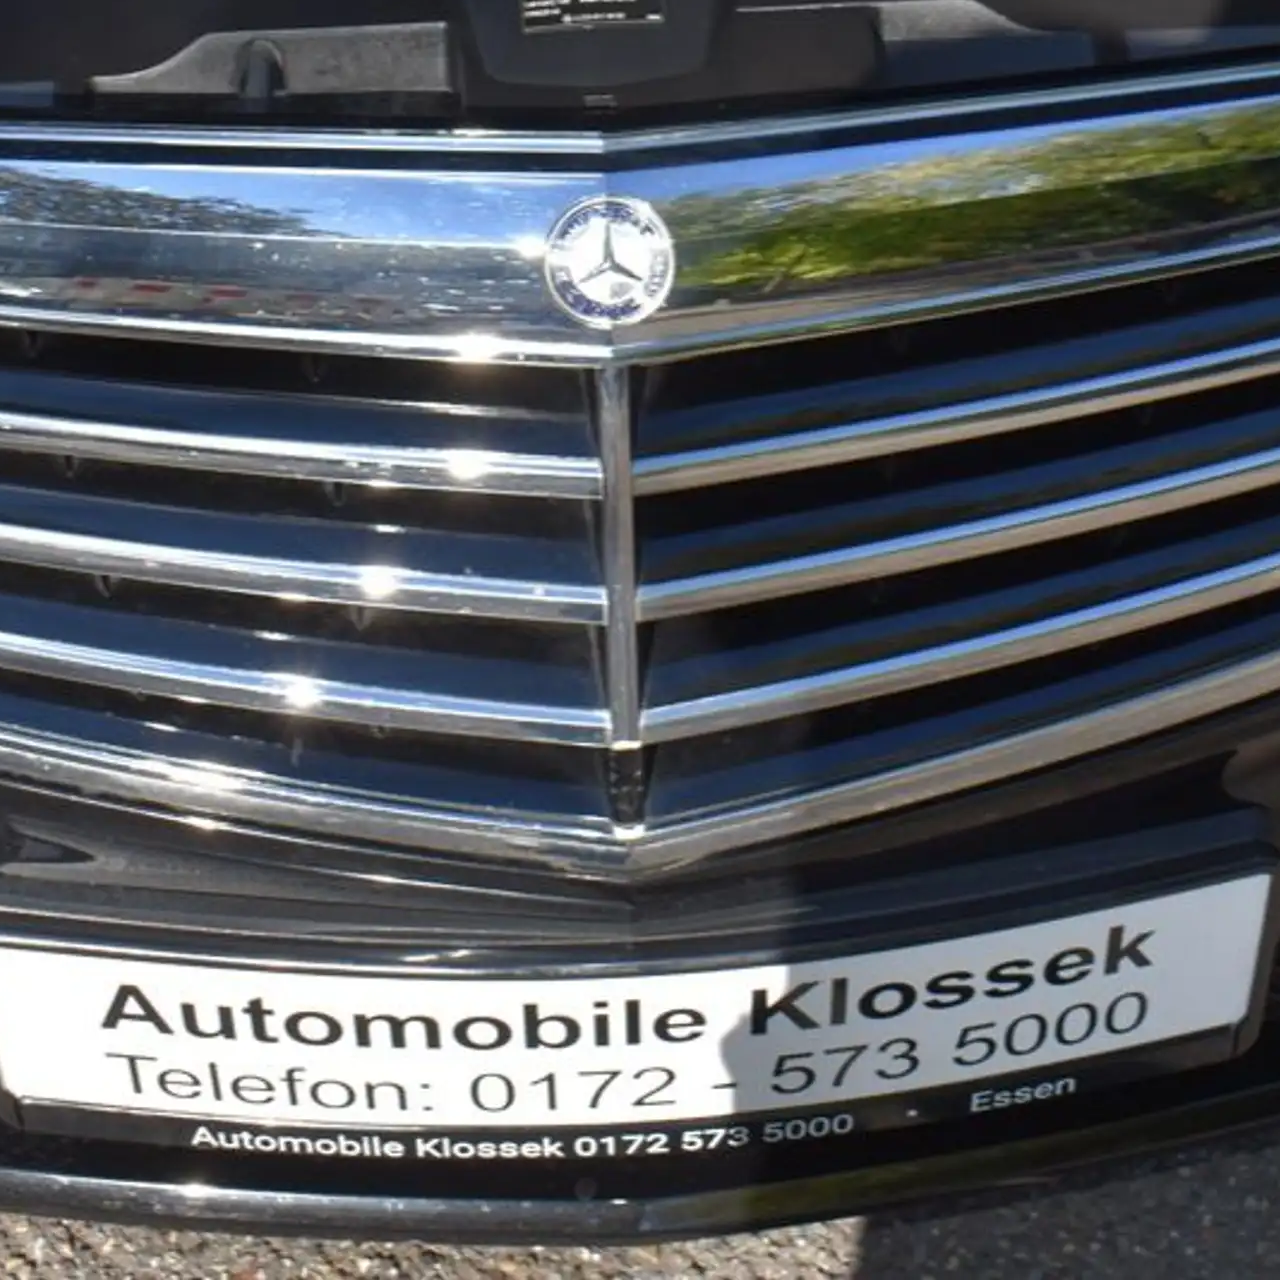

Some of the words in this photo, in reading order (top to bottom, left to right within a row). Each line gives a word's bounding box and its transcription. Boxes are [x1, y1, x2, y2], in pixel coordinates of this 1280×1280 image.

[101, 983, 708, 1051] Automobile
[750, 925, 1156, 1036] Klossek
[105, 1051, 433, 1112] Telefon:
[469, 1066, 677, 1113] 0172
[771, 1037, 920, 1095] 573
[952, 991, 1149, 1067] 5000
[191, 1125, 406, 1158] Automobile
[416, 1137, 566, 1160] Klossek
[573, 1131, 672, 1157] 0172
[679, 1126, 750, 1151] 573
[762, 1113, 856, 1144] 5000
[969, 1076, 1078, 1113] Essen
